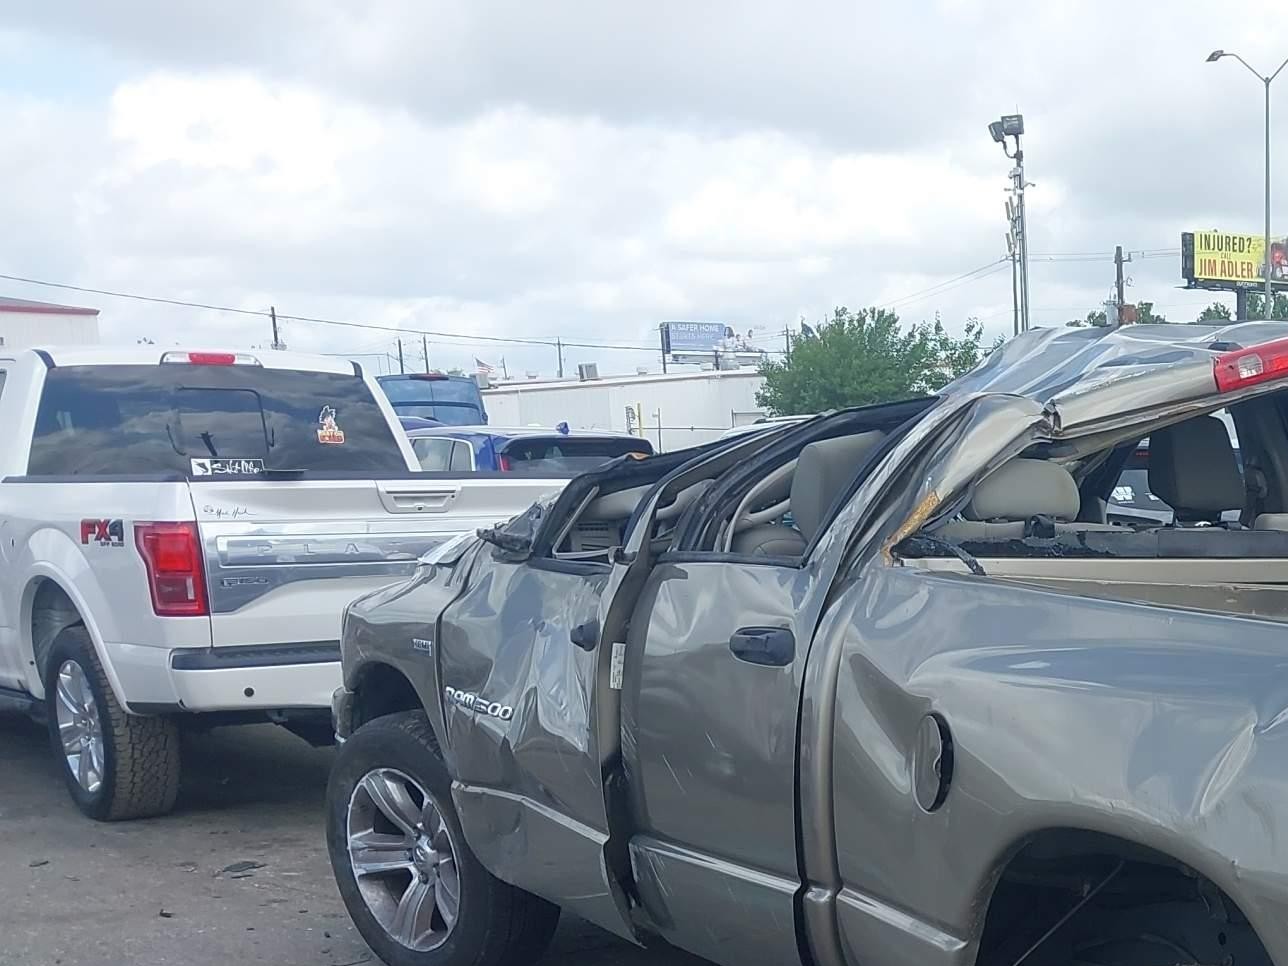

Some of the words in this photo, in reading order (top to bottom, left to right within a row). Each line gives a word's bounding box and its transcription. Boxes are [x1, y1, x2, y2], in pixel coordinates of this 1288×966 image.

[1199, 233, 1252, 253] INJURED?
[1198, 259, 1217, 277] JIM
[1220, 259, 1254, 279] ADLER
[80, 518, 124, 545] FX4
